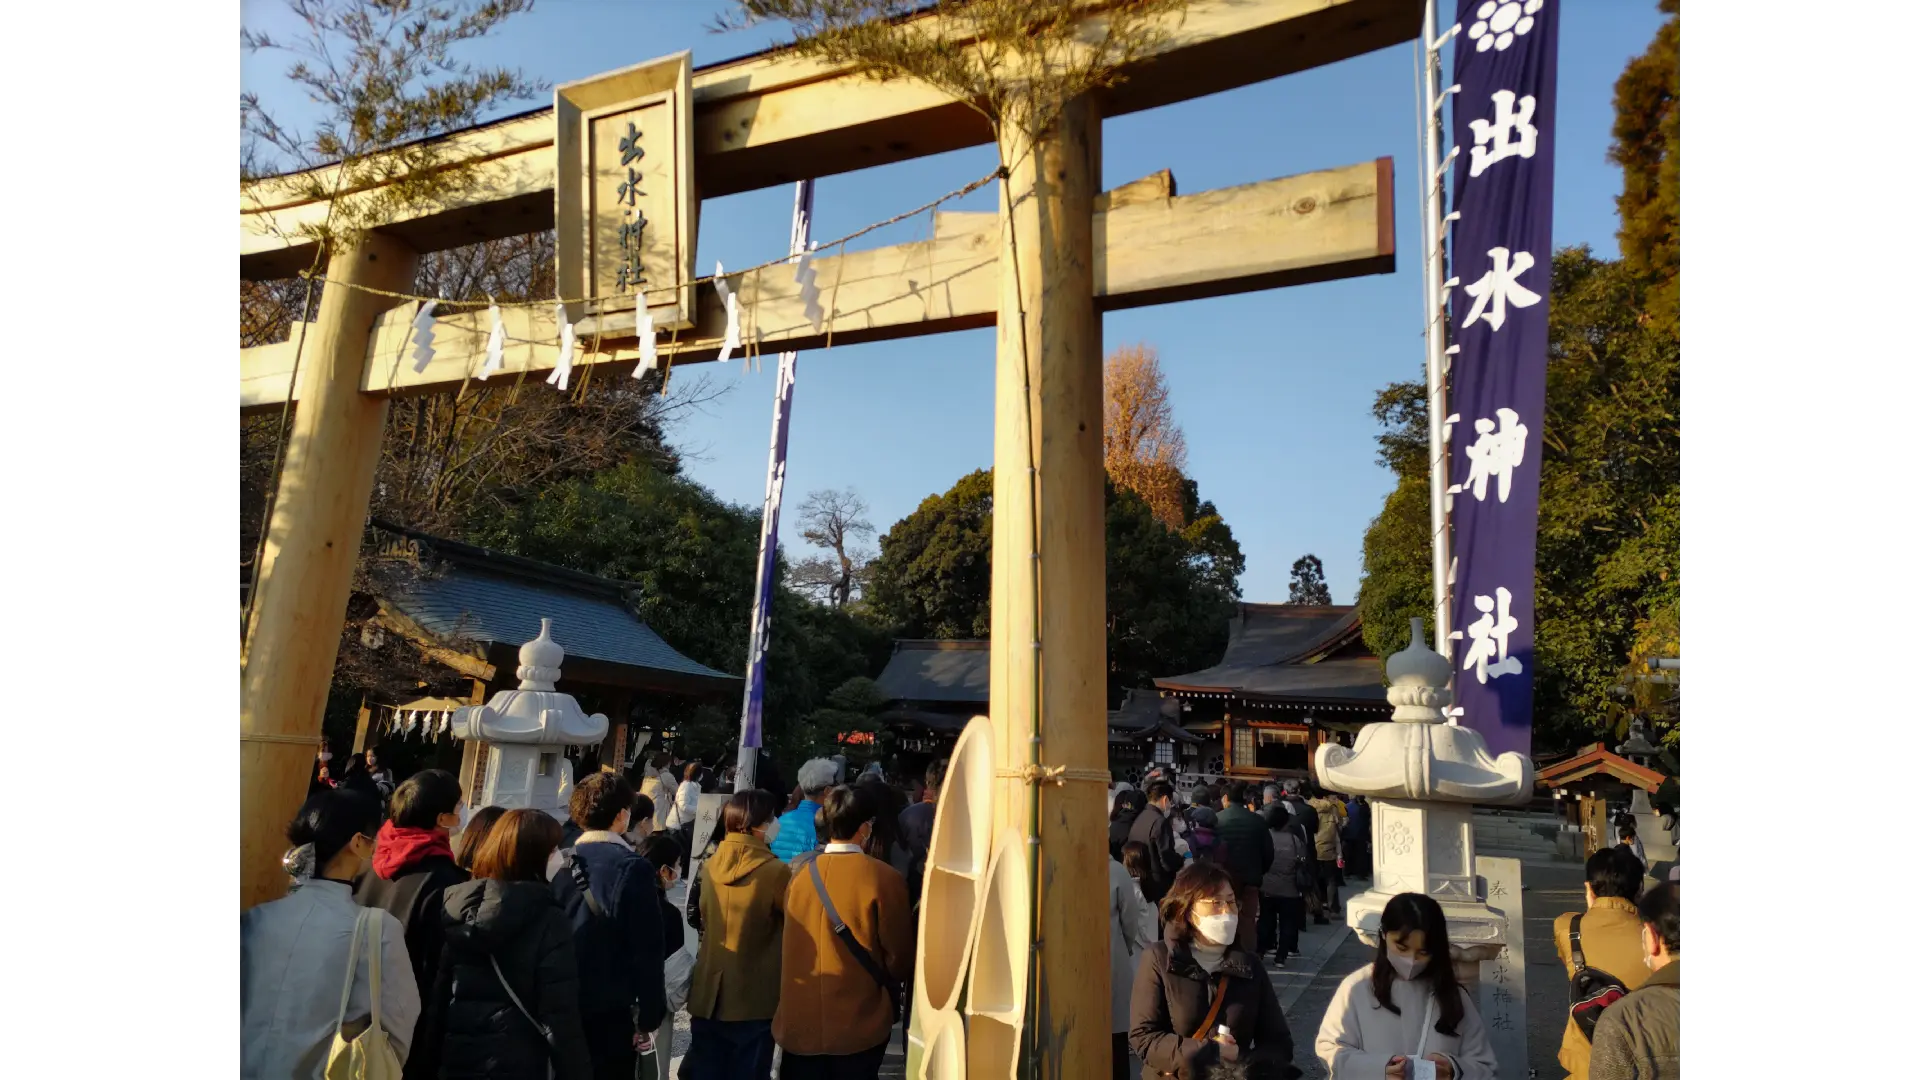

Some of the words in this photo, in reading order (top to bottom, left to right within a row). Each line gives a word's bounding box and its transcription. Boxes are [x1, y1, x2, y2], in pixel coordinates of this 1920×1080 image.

[616, 121, 648, 293] 出水神社
[1461, 89, 1542, 685] 出水神社
